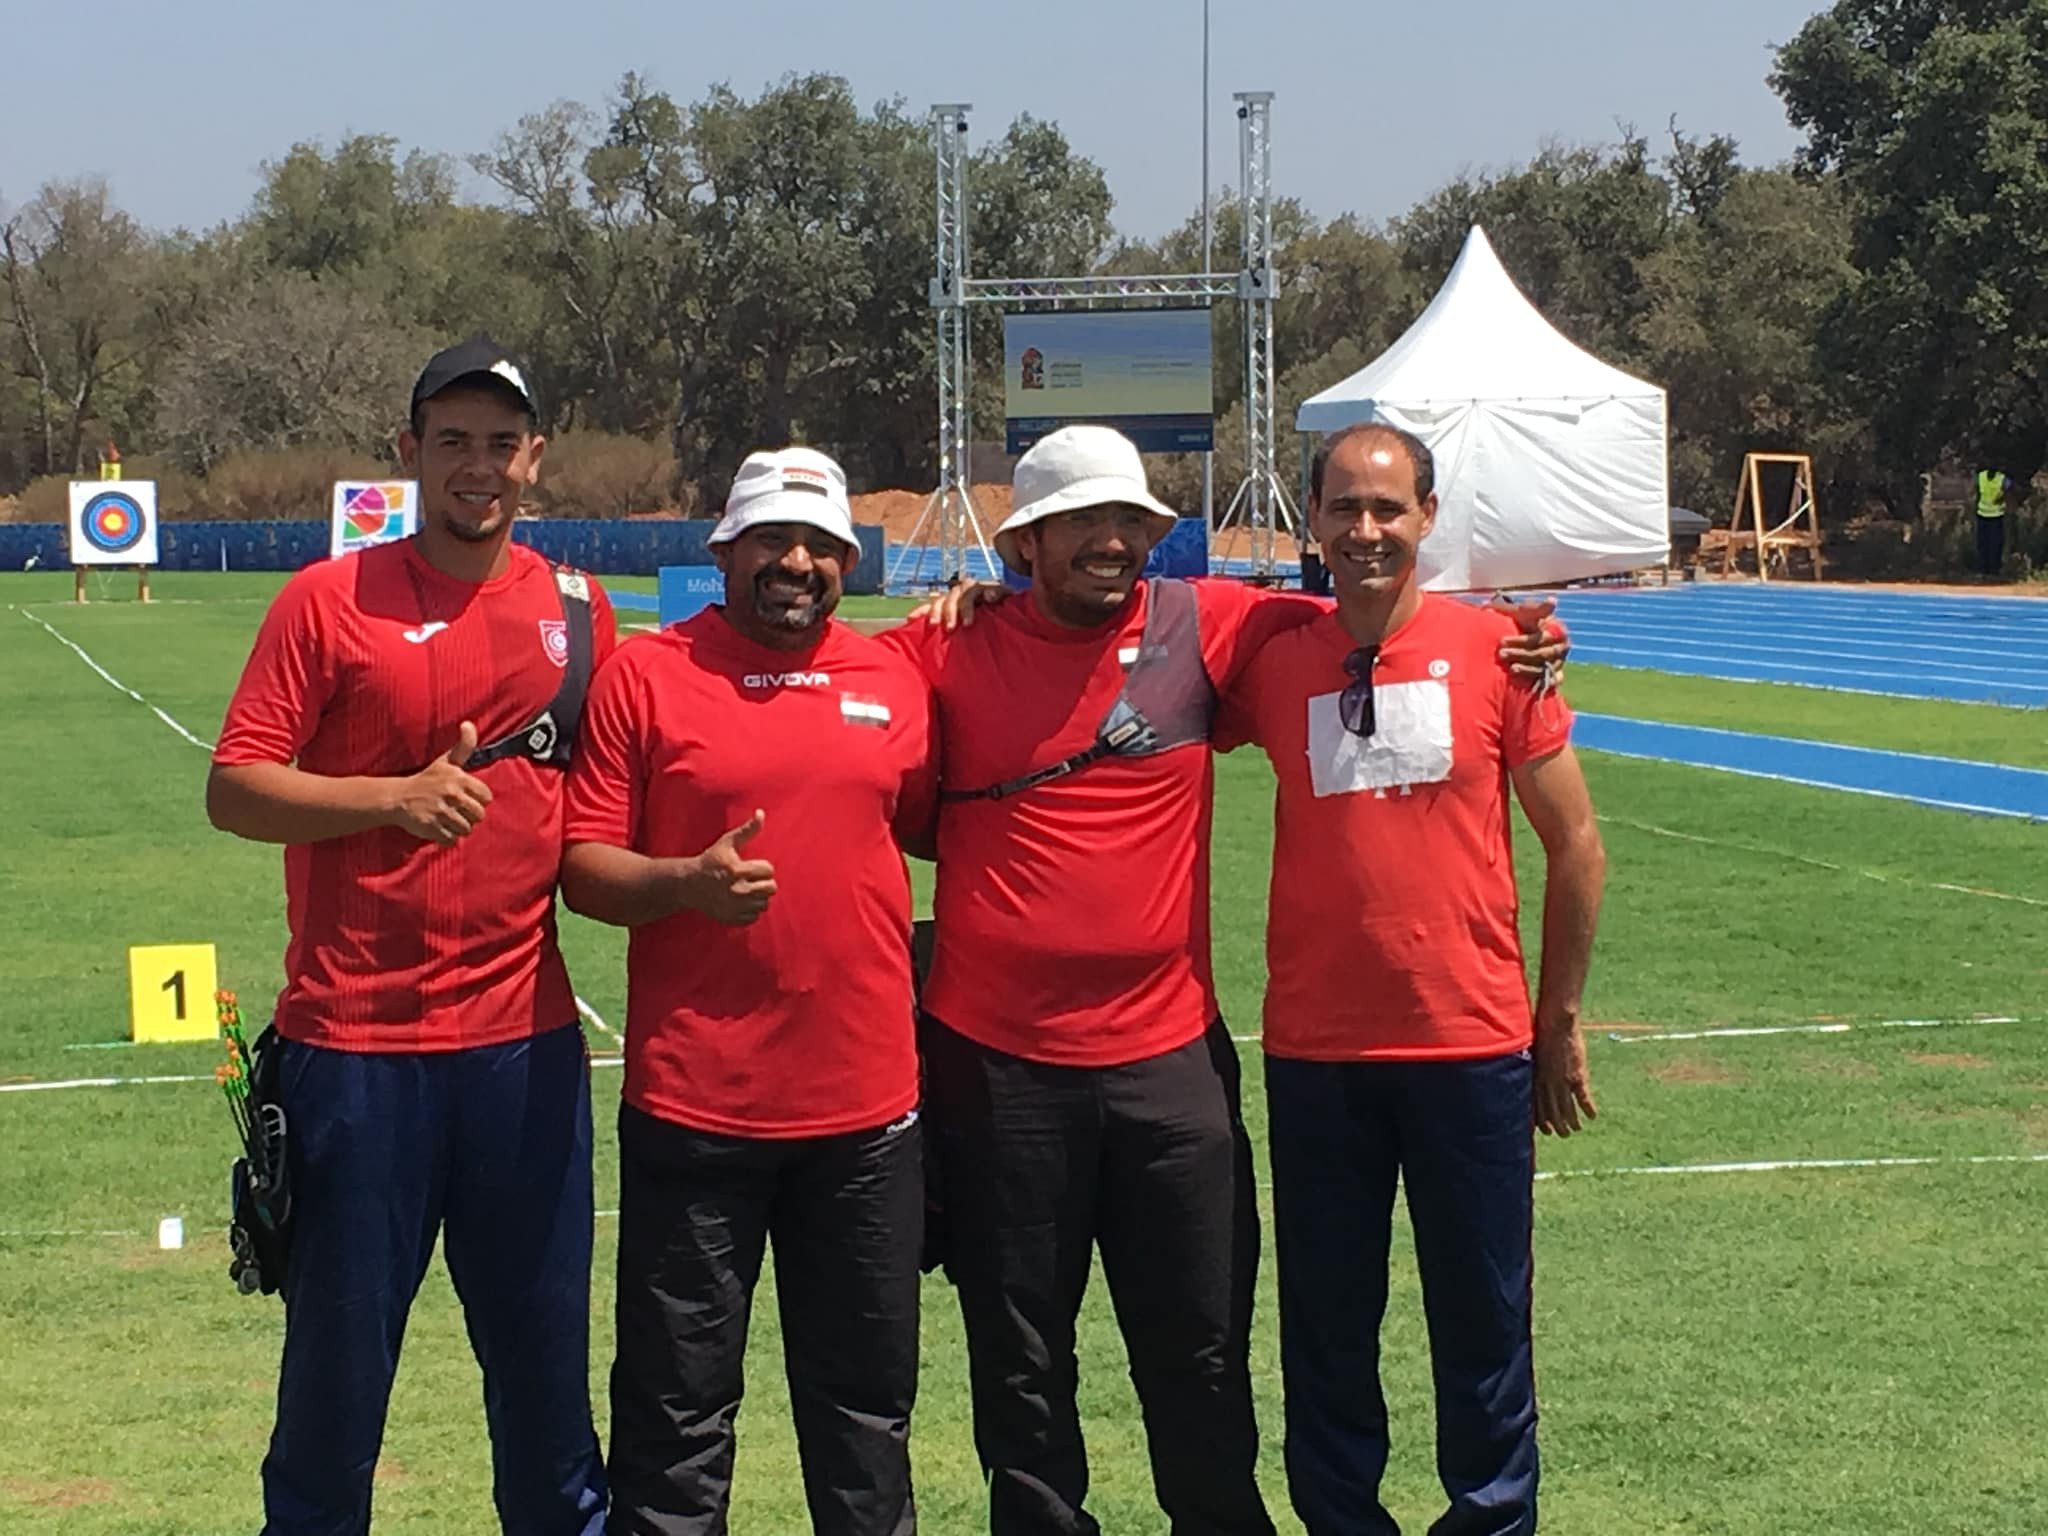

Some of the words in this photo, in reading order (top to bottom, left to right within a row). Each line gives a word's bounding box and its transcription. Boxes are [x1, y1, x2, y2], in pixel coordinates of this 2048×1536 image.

[687, 577, 725, 592] Moh
[743, 672, 830, 688] GIVOVA
[161, 970, 186, 1020] 1
